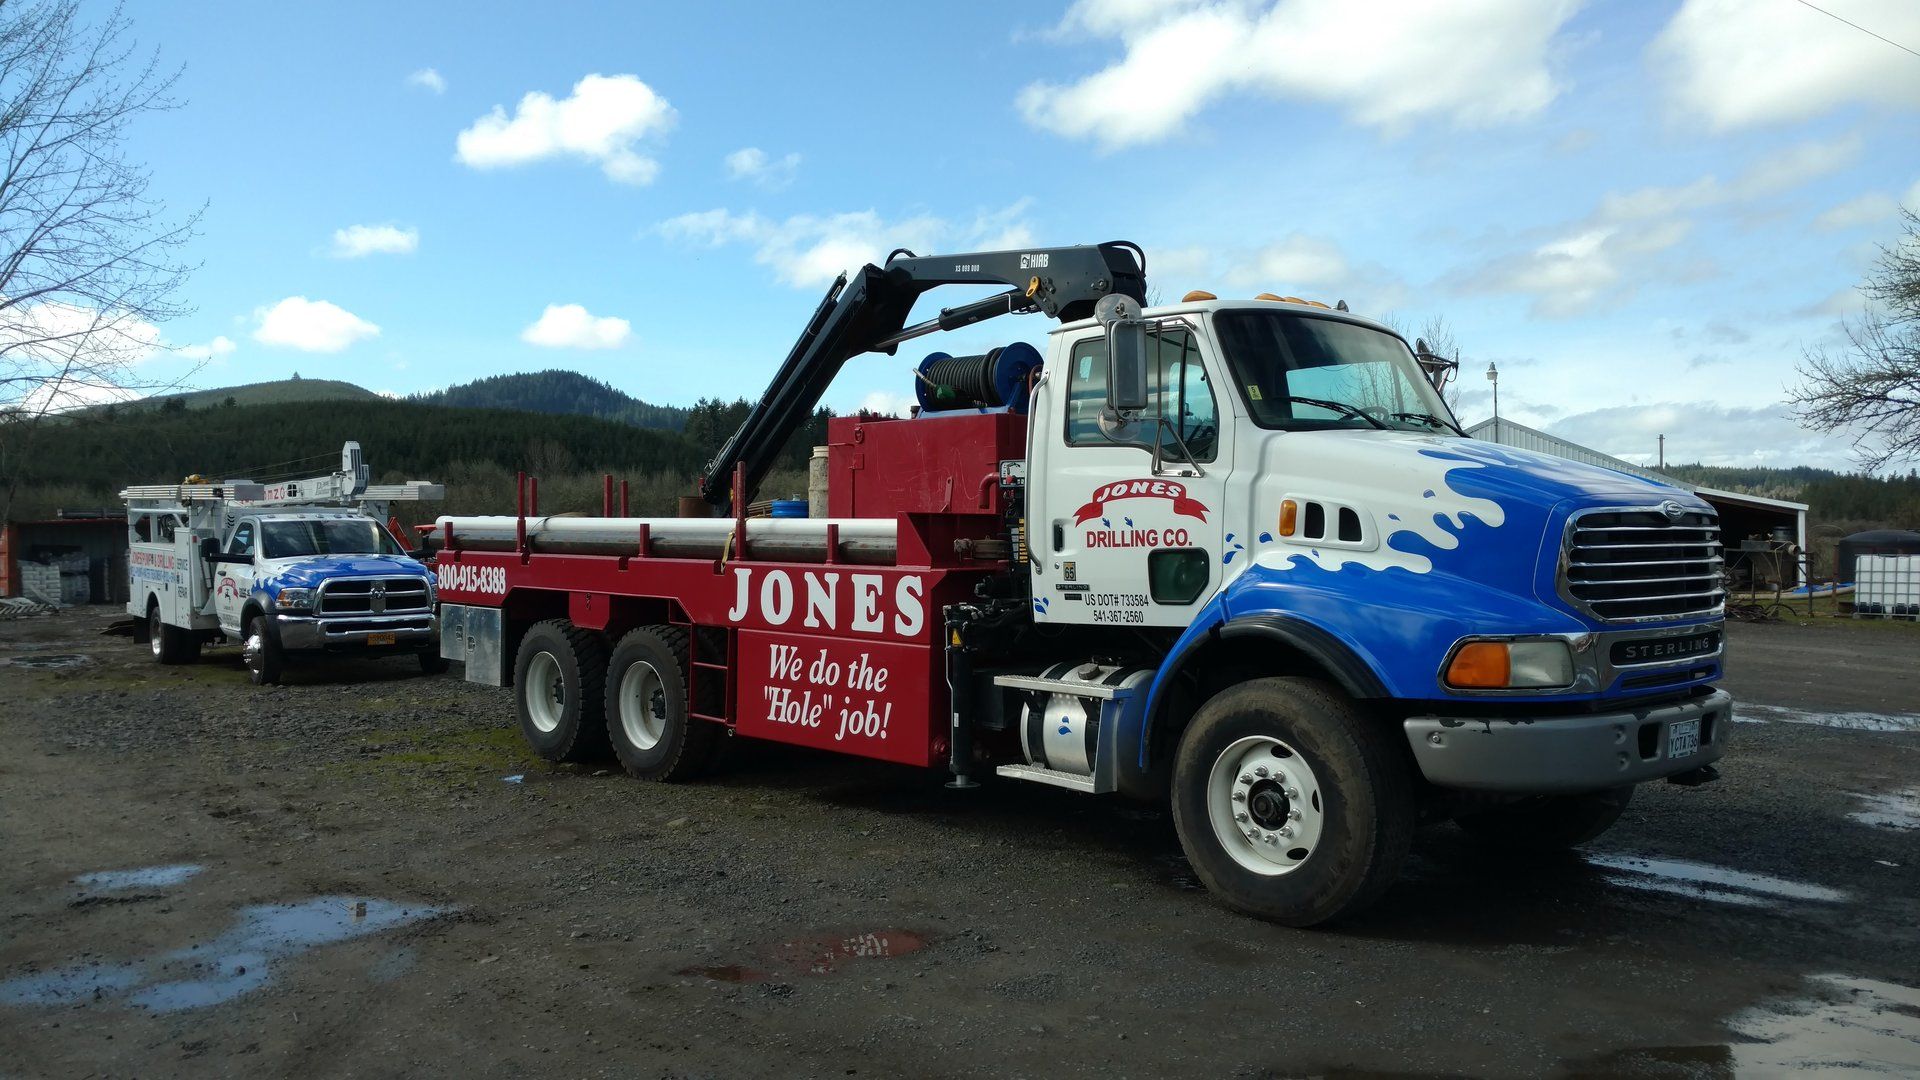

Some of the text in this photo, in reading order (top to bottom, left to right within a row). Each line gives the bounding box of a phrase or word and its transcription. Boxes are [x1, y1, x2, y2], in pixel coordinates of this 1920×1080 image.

[1031, 253, 1049, 268] HIAB
[1096, 481, 1182, 502] JONES
[1086, 528, 1193, 548] DRILLING CO.
[438, 563, 506, 595] 800-915-8388
[1065, 567, 1075, 580] 65
[728, 567, 925, 637] JONES
[1084, 594, 1096, 606] US
[1097, 594, 1119, 606] DOT#
[1120, 594, 1149, 607] 733584
[1093, 610, 1144, 623] 541-367-2560
[1625, 637, 1709, 659] STERLING
[769, 643, 888, 693] We do the
[764, 685, 892, 741] "Hole" job!
